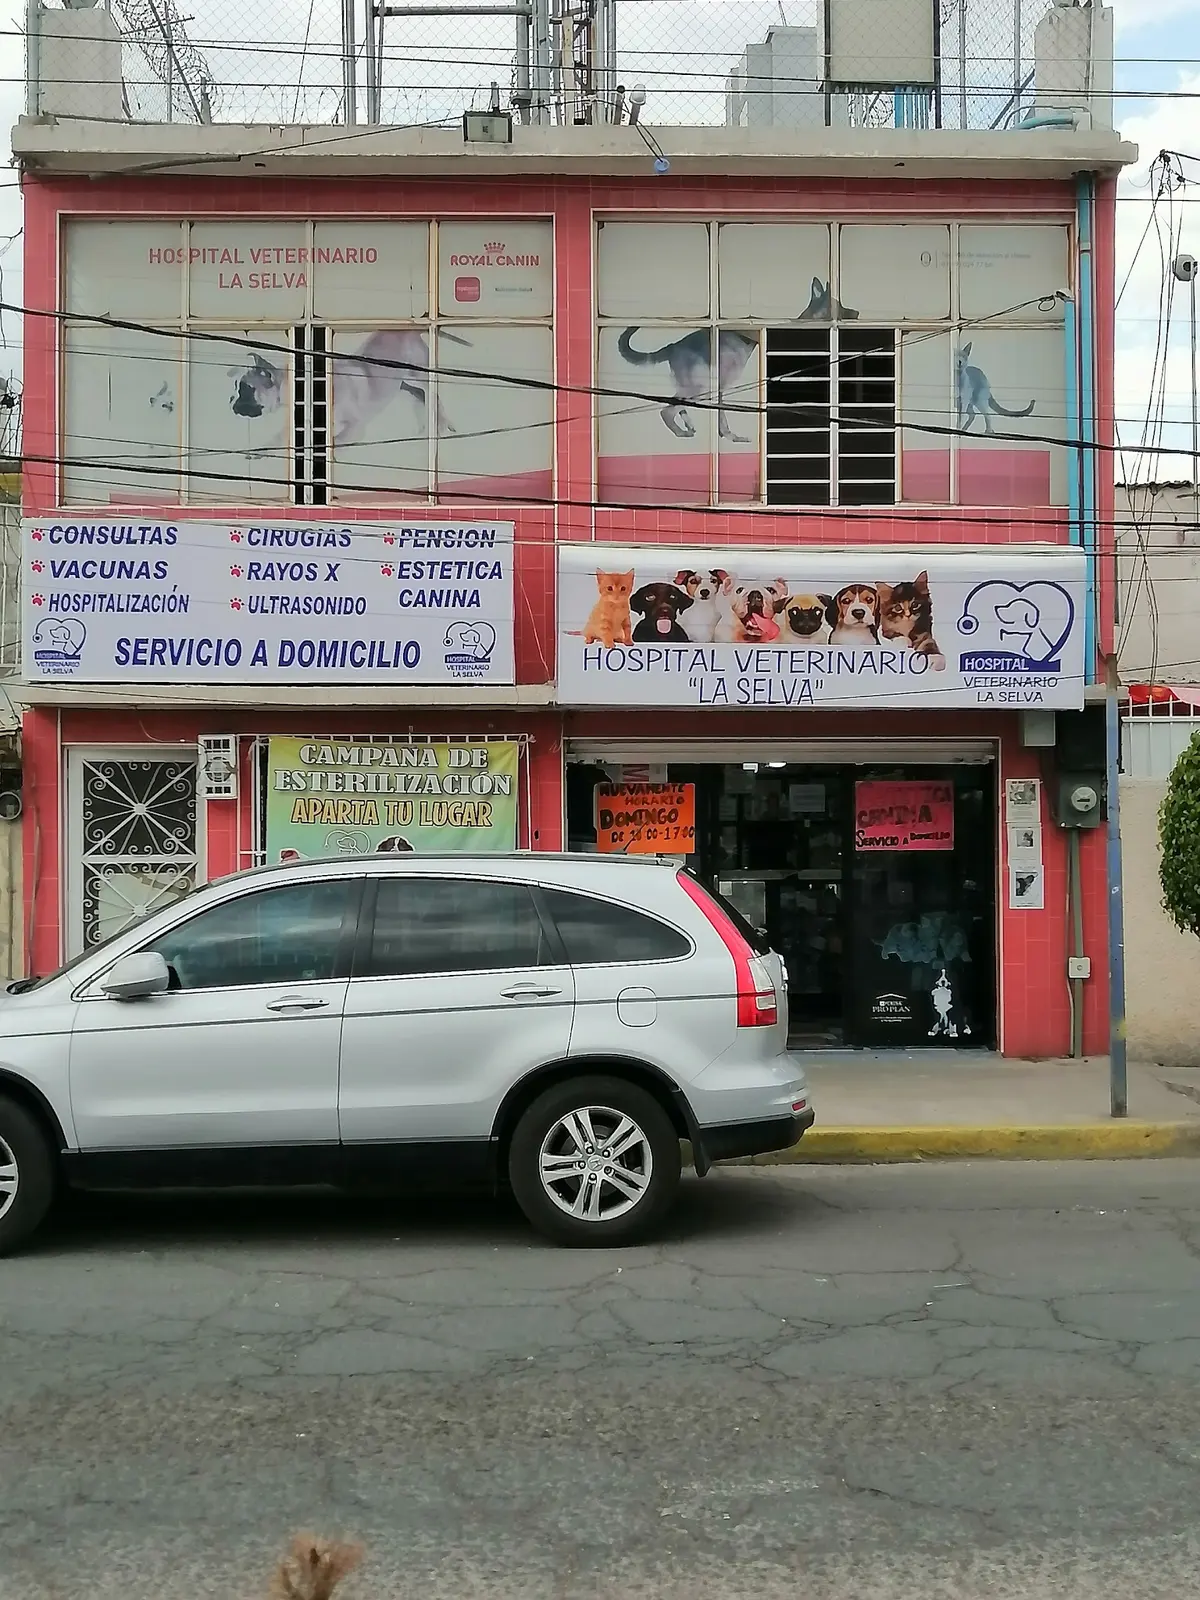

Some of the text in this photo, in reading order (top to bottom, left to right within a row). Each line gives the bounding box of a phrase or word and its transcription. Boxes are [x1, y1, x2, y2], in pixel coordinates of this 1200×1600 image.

[149, 248, 378, 264] HOSPITAL VETERINARIO
[450, 255, 540, 266] ROYAL CANIN
[218, 273, 307, 289] LA SELVA
[49, 525, 178, 545] CONSULTAS
[399, 528, 496, 549] PENSION
[50, 560, 169, 580] VACUNAS
[247, 561, 341, 582] RAYOS X
[397, 560, 503, 580] ESTETICA
[48, 585, 190, 613] HOSPITALIZACIÓN
[248, 595, 367, 616] ULTRASONIDO
[399, 589, 481, 608] CANINA
[115, 637, 421, 669] SERVICIO A DOMICILIO
[583, 648, 929, 675] HOSPITAL VETERINARIO
[963, 657, 1030, 672] HOSPITAL
[963, 676, 1058, 688] VETERINARIO
[977, 691, 1043, 703] LA SELVA
[448, 747, 488, 769] DE
[273, 770, 512, 796] ESTERILIZACIÓN
[625, 796, 685, 806] HORARIO
[291, 798, 494, 828] APARTA TU LUGAR
[600, 808, 679, 830] DOMINGO
